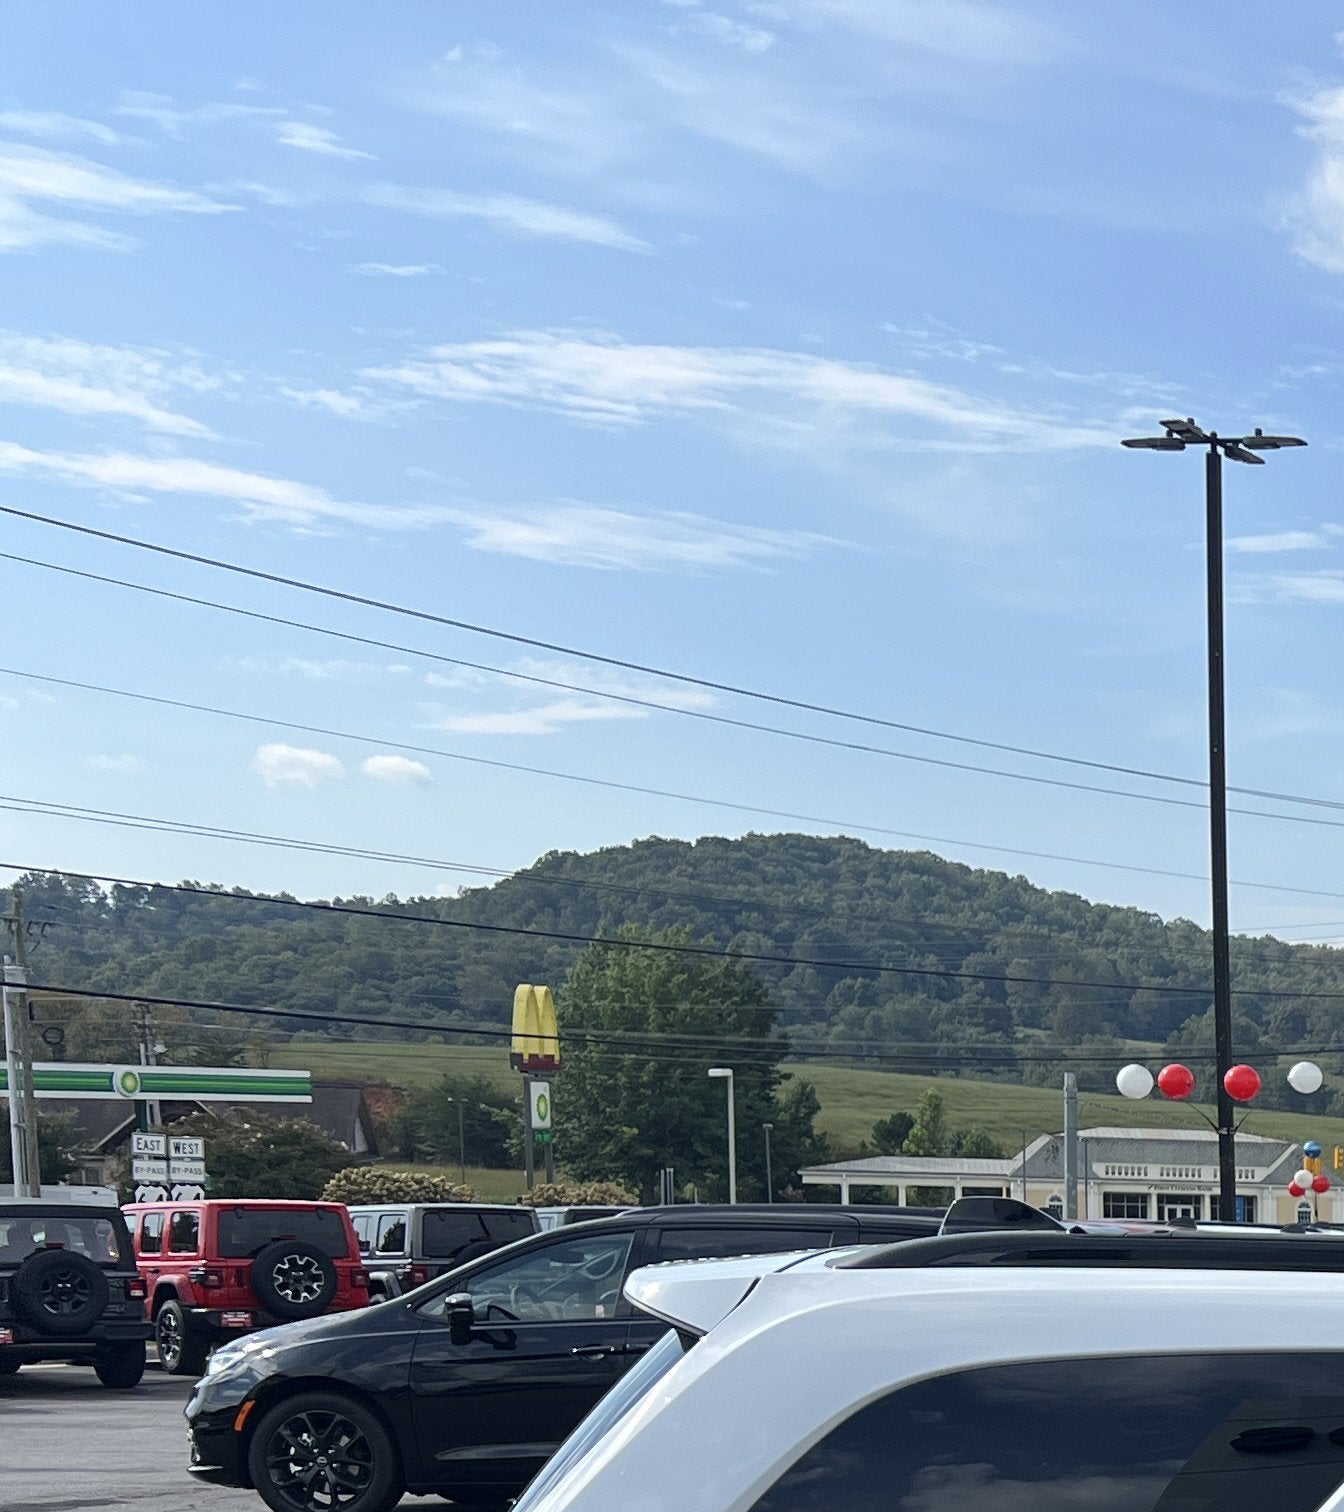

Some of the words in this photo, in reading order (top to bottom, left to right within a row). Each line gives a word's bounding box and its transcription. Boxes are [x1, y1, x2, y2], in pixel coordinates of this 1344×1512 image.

[136, 1137, 161, 1152] EAST
[173, 1141, 200, 1155] WEST
[172, 1166, 202, 1176] BY-PASS
